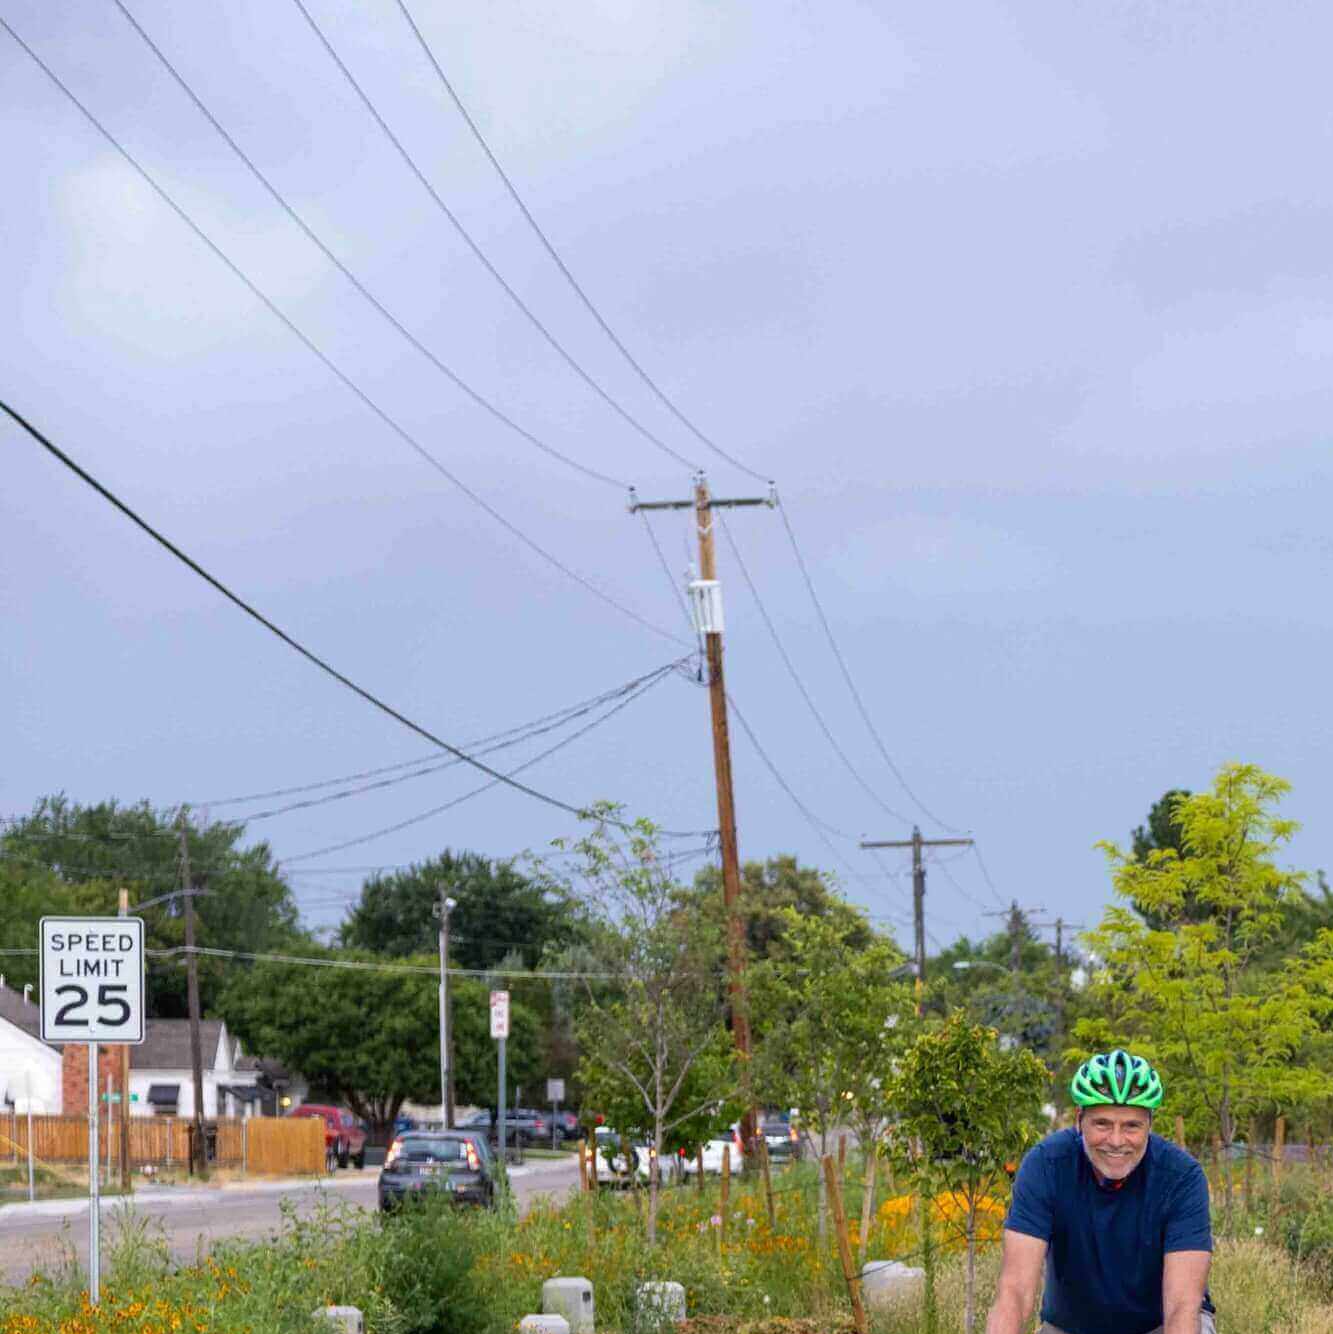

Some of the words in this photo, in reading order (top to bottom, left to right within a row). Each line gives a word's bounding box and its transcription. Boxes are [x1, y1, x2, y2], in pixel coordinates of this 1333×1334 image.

[51, 934, 133, 951] SPEED
[60, 960, 124, 976] LIMIT
[55, 985, 131, 1026] 25
